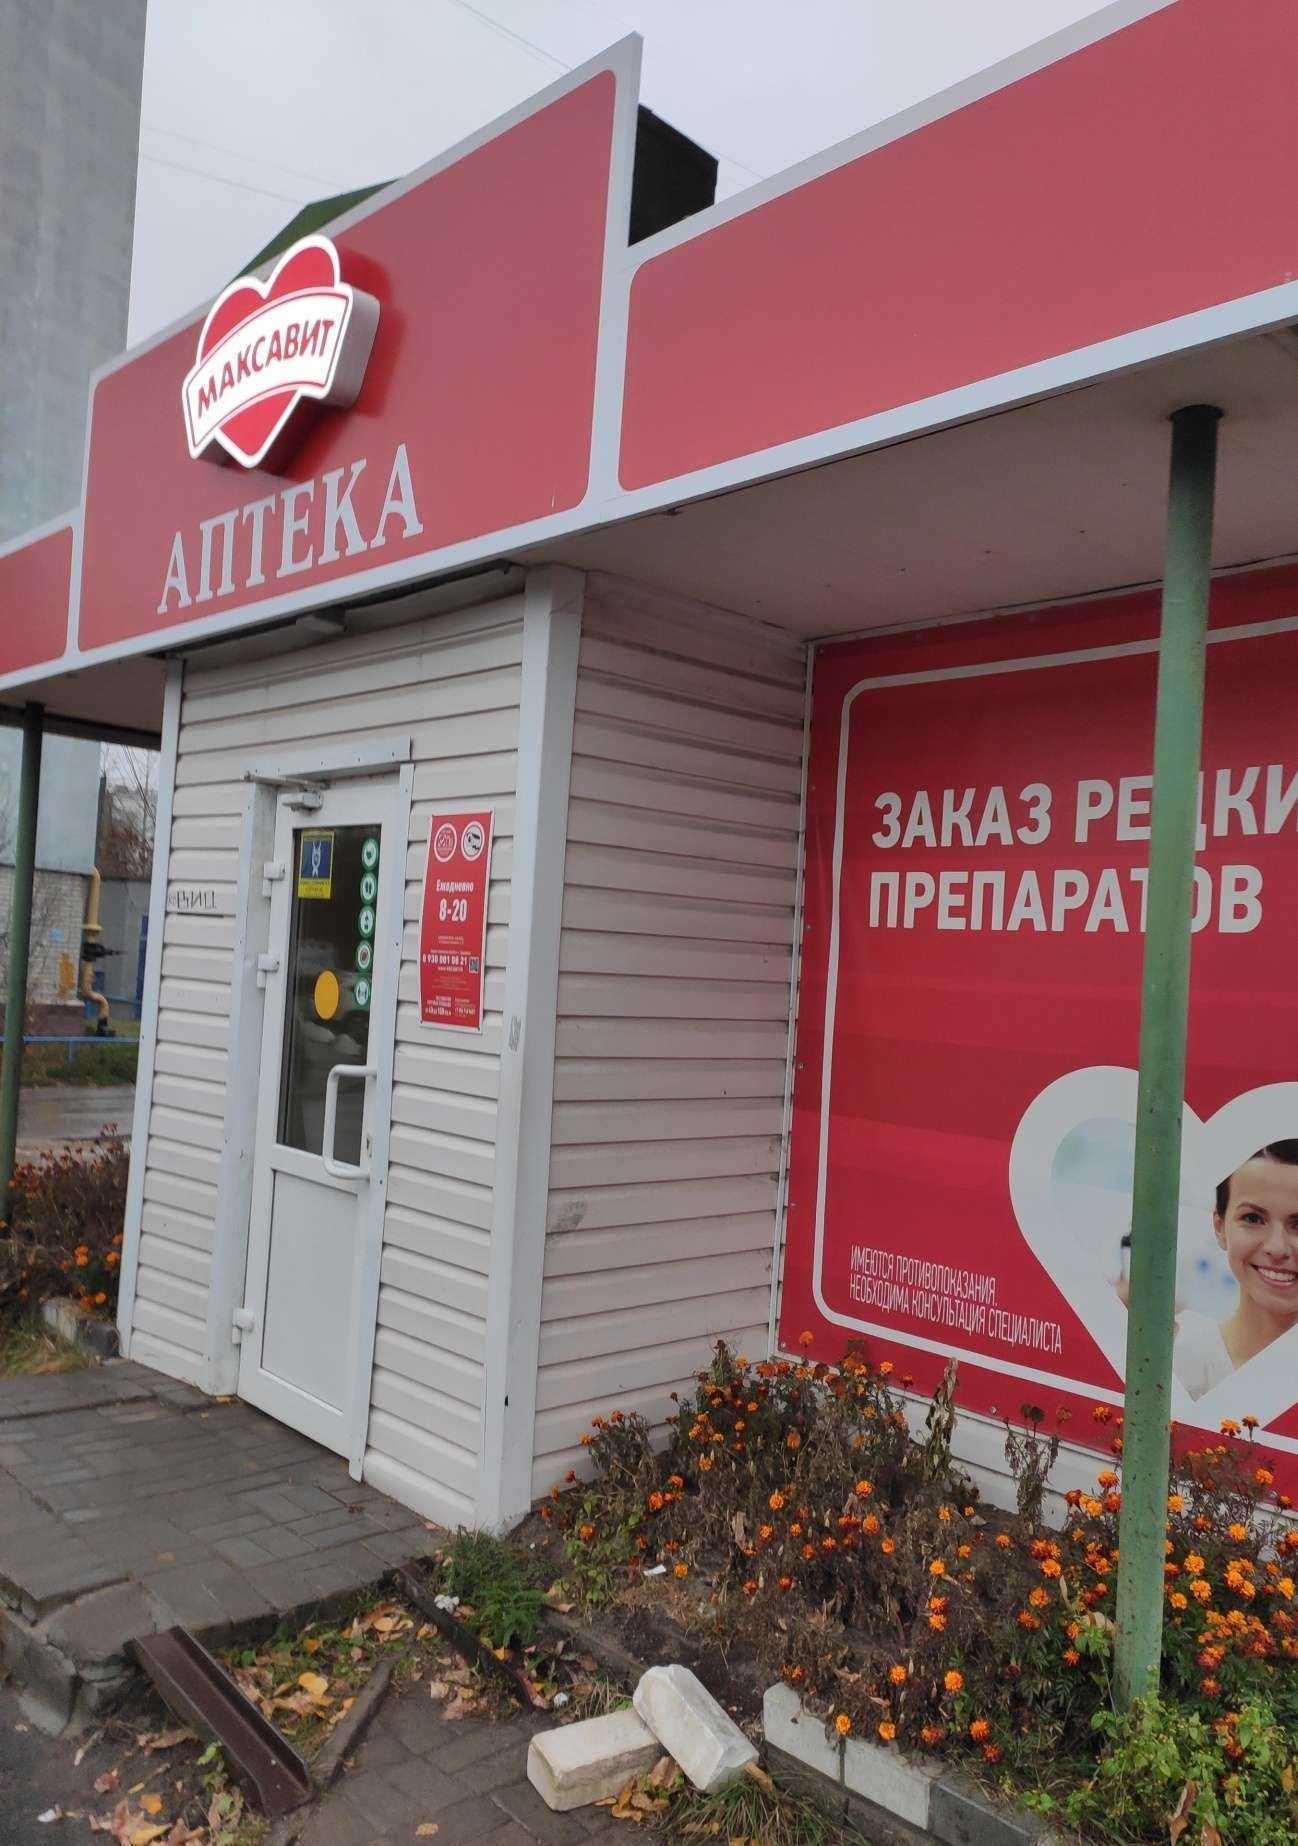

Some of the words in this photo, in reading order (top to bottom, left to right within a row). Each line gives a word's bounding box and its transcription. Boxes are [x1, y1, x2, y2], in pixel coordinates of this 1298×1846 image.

[197, 319, 335, 419] МАКСАВИТ
[157, 443, 423, 614] АПТЕКА
[871, 783, 1053, 848] ЗАКАЗ
[850, 1274, 910, 1314] НЕОБХОДИМА
[911, 1289, 986, 1336] КОНСУЛЬТАЦИЯ
[988, 1308, 1062, 1354] СПЕЦИАЛИСТА
[851, 1245, 894, 1280] ИМЕЮТСЯ
[895, 1255, 998, 1306] ПРОТИВОПОКАЗАНИЯ.
